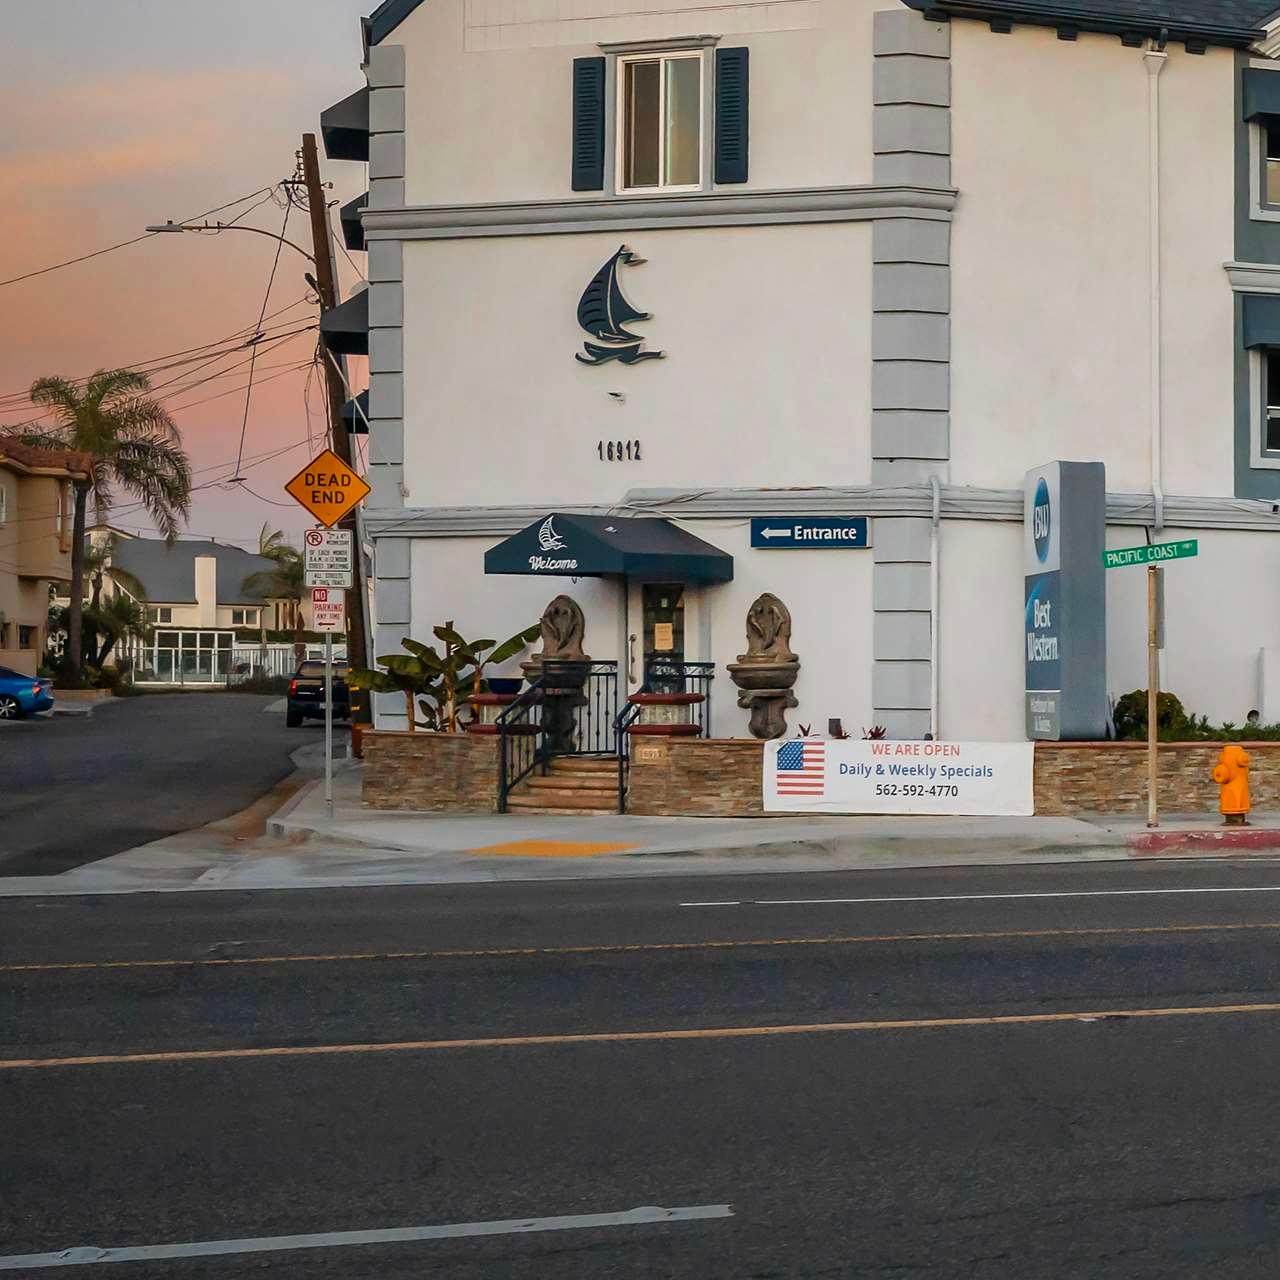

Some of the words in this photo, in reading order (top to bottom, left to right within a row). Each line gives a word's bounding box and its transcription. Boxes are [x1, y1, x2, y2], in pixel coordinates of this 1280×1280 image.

[597, 439, 641, 462] 16912
[304, 472, 352, 487] DEAD
[311, 490, 345, 505] END
[1034, 503, 1050, 540] BW
[794, 525, 857, 541] Entrance
[528, 555, 578, 571] Welcome
[1106, 549, 1144, 566] PACIFIC
[1147, 544, 1179, 561] COAST
[313, 590, 327, 601] NO
[314, 603, 343, 612] PARKING
[1033, 599, 1052, 629] Best
[871, 743, 891, 756] WE
[894, 743, 920, 756] ARE
[924, 744, 961, 757] OPEN
[839, 763, 872, 779] Daily
[875, 763, 885, 776] &
[889, 764, 937, 780] Weekly
[940, 765, 994, 780] Specials
[875, 783, 959, 798] 562-592-4770
